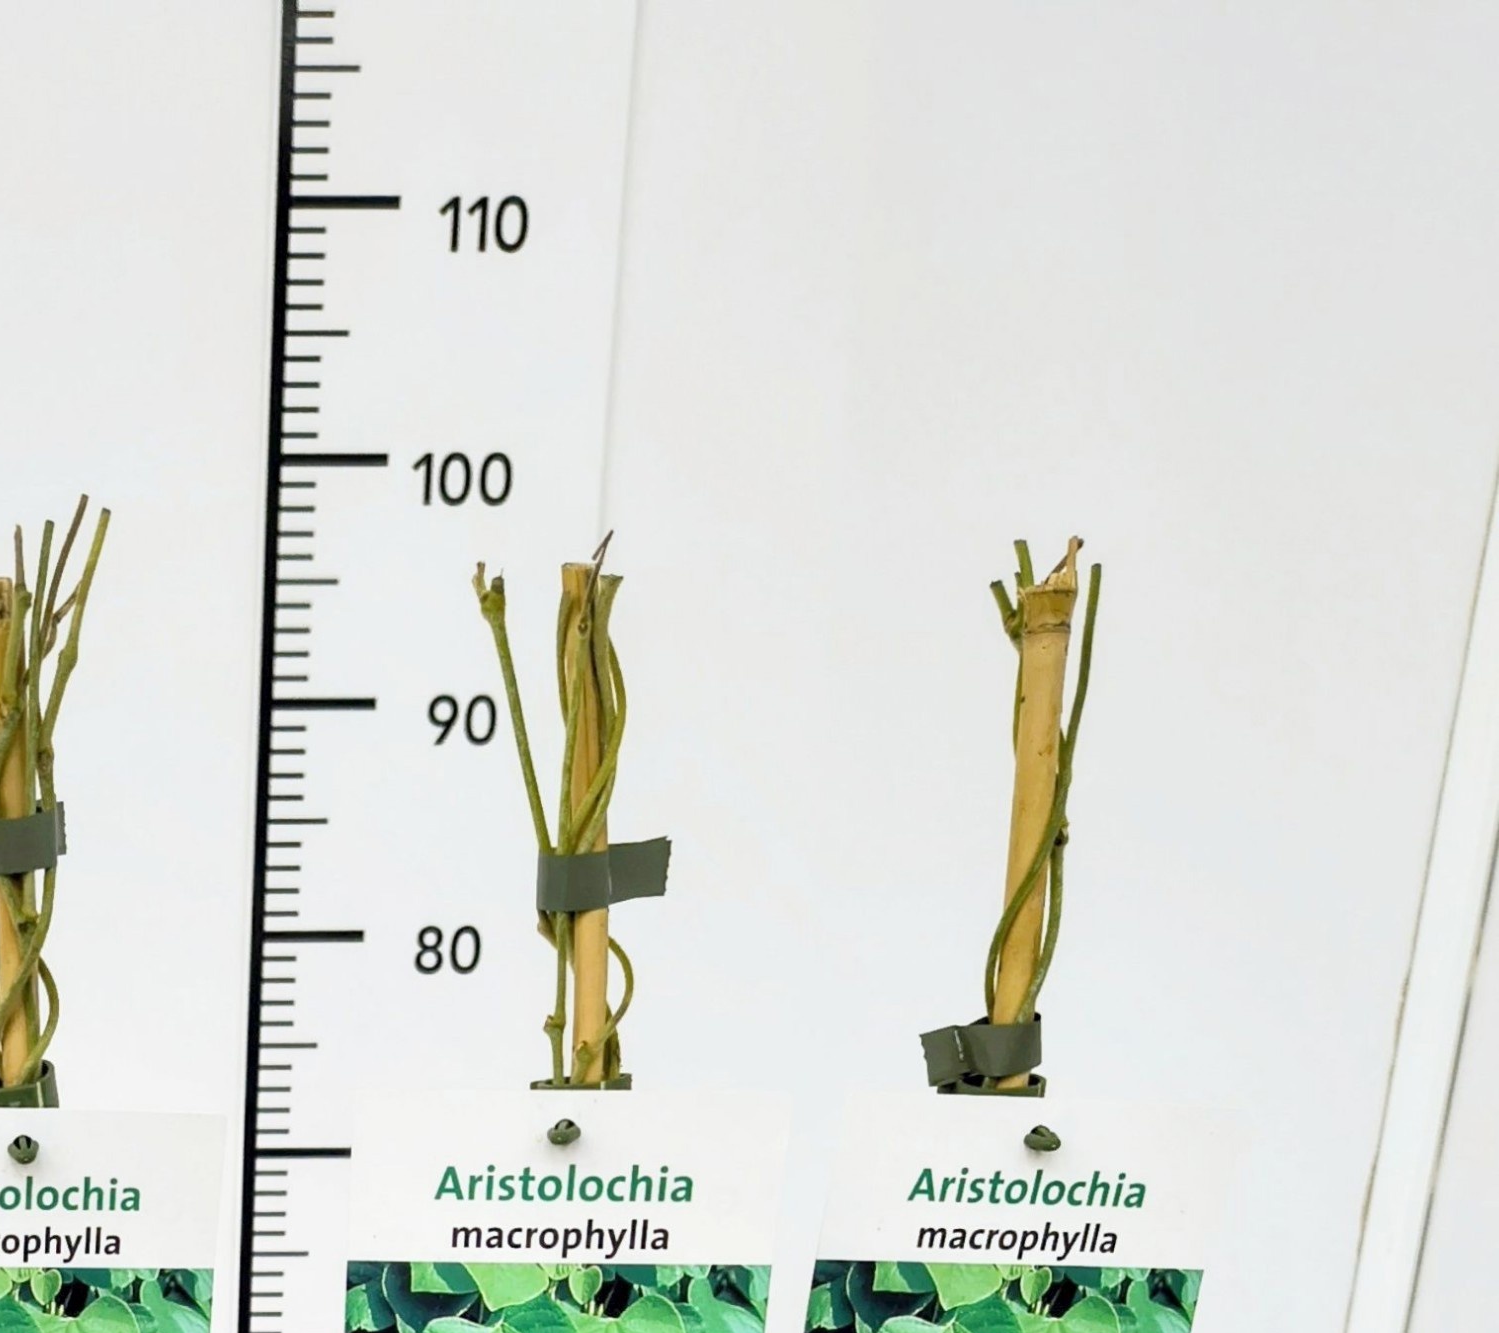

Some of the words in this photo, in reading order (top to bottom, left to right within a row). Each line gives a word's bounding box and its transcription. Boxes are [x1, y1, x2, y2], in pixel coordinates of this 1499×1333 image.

[439, 194, 529, 254] 110
[412, 451, 513, 507] 100
[427, 694, 497, 746] 90
[414, 925, 482, 975] 80
[434, 1163, 694, 1203] Aristolochia
[907, 1167, 1146, 1209] Aristolochia
[451, 1218, 669, 1260] macrophylla
[916, 1221, 1118, 1262] macrophylla
